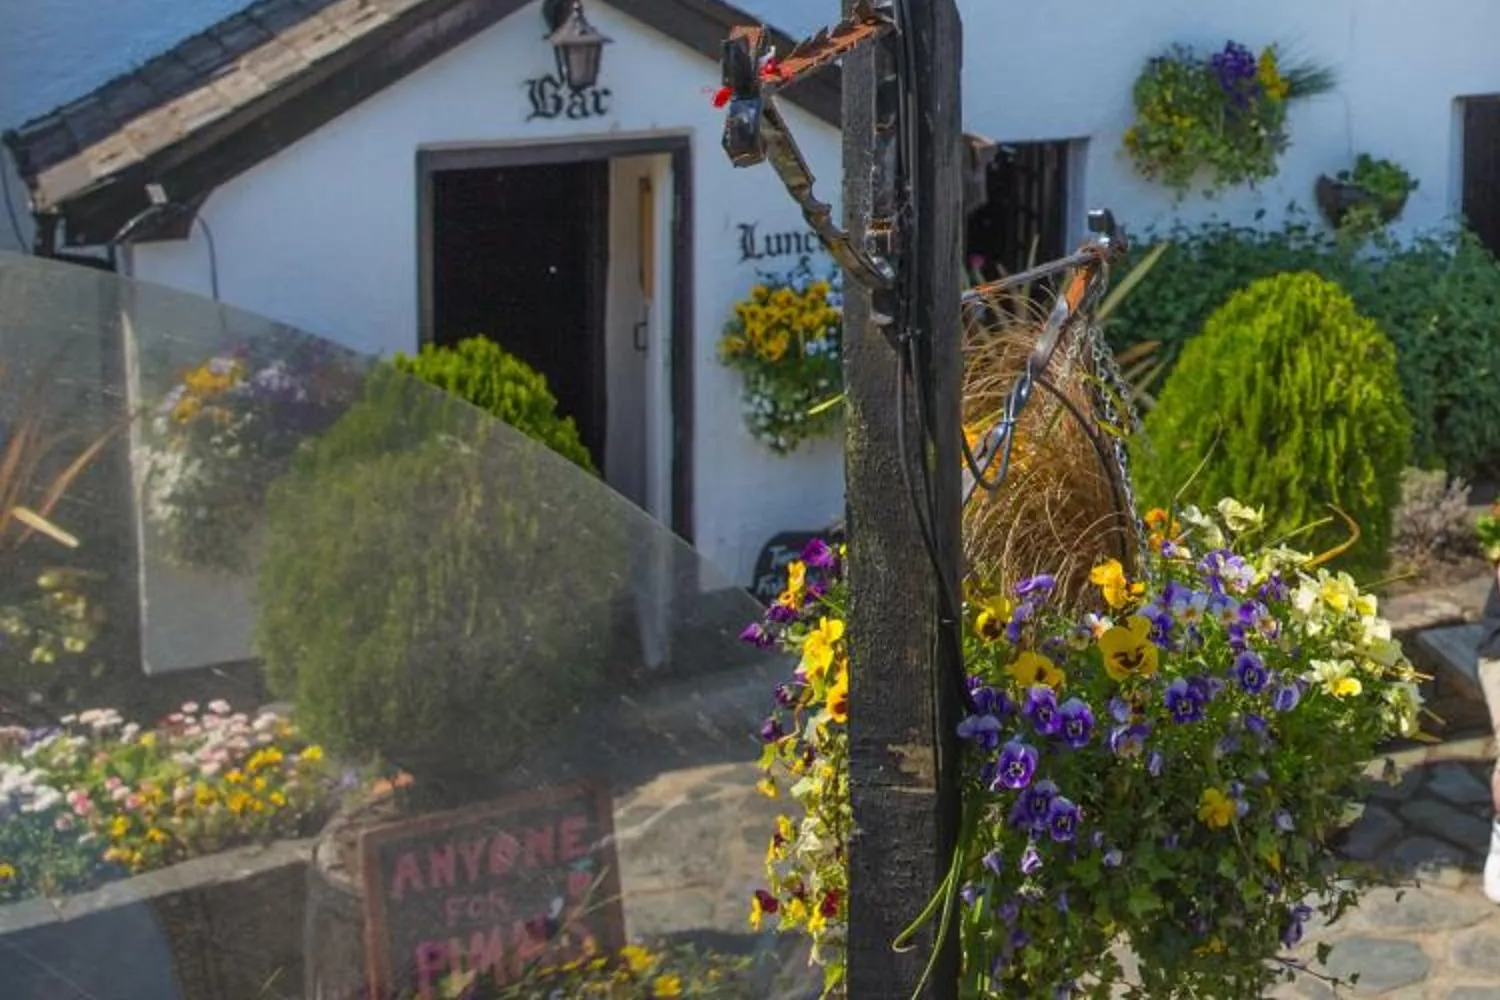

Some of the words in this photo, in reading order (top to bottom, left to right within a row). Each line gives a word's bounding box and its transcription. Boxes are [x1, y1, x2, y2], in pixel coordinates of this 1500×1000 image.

[522, 73, 612, 122] Bar
[737, 221, 826, 264] Lunc
[391, 813, 592, 902] ANYONE
